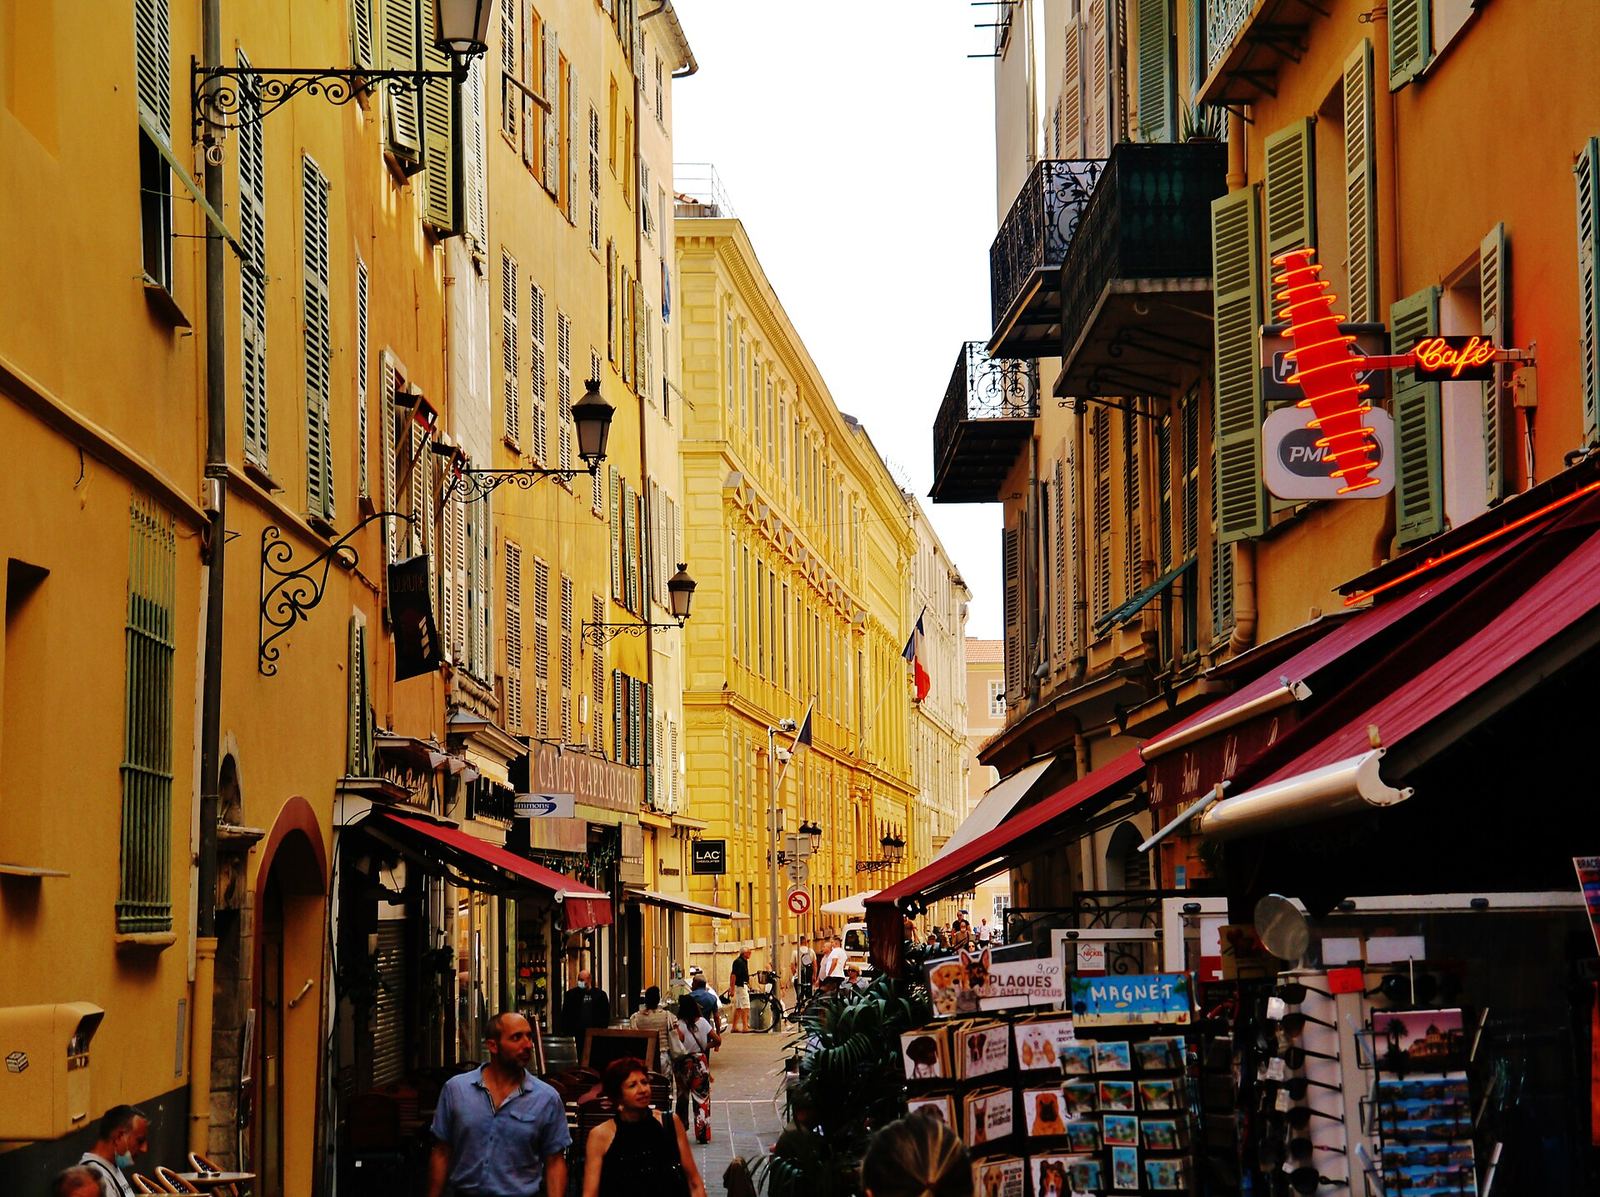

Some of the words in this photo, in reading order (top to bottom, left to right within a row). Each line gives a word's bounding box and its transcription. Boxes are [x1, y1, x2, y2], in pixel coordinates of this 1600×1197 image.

[1416, 336, 1496, 377] Café
[538, 749, 576, 793] CAVES
[578, 759, 638, 806] CAPRIOGLIO
[989, 975, 1052, 988] PLAQUES
[1090, 984, 1173, 1003] MAGNET
